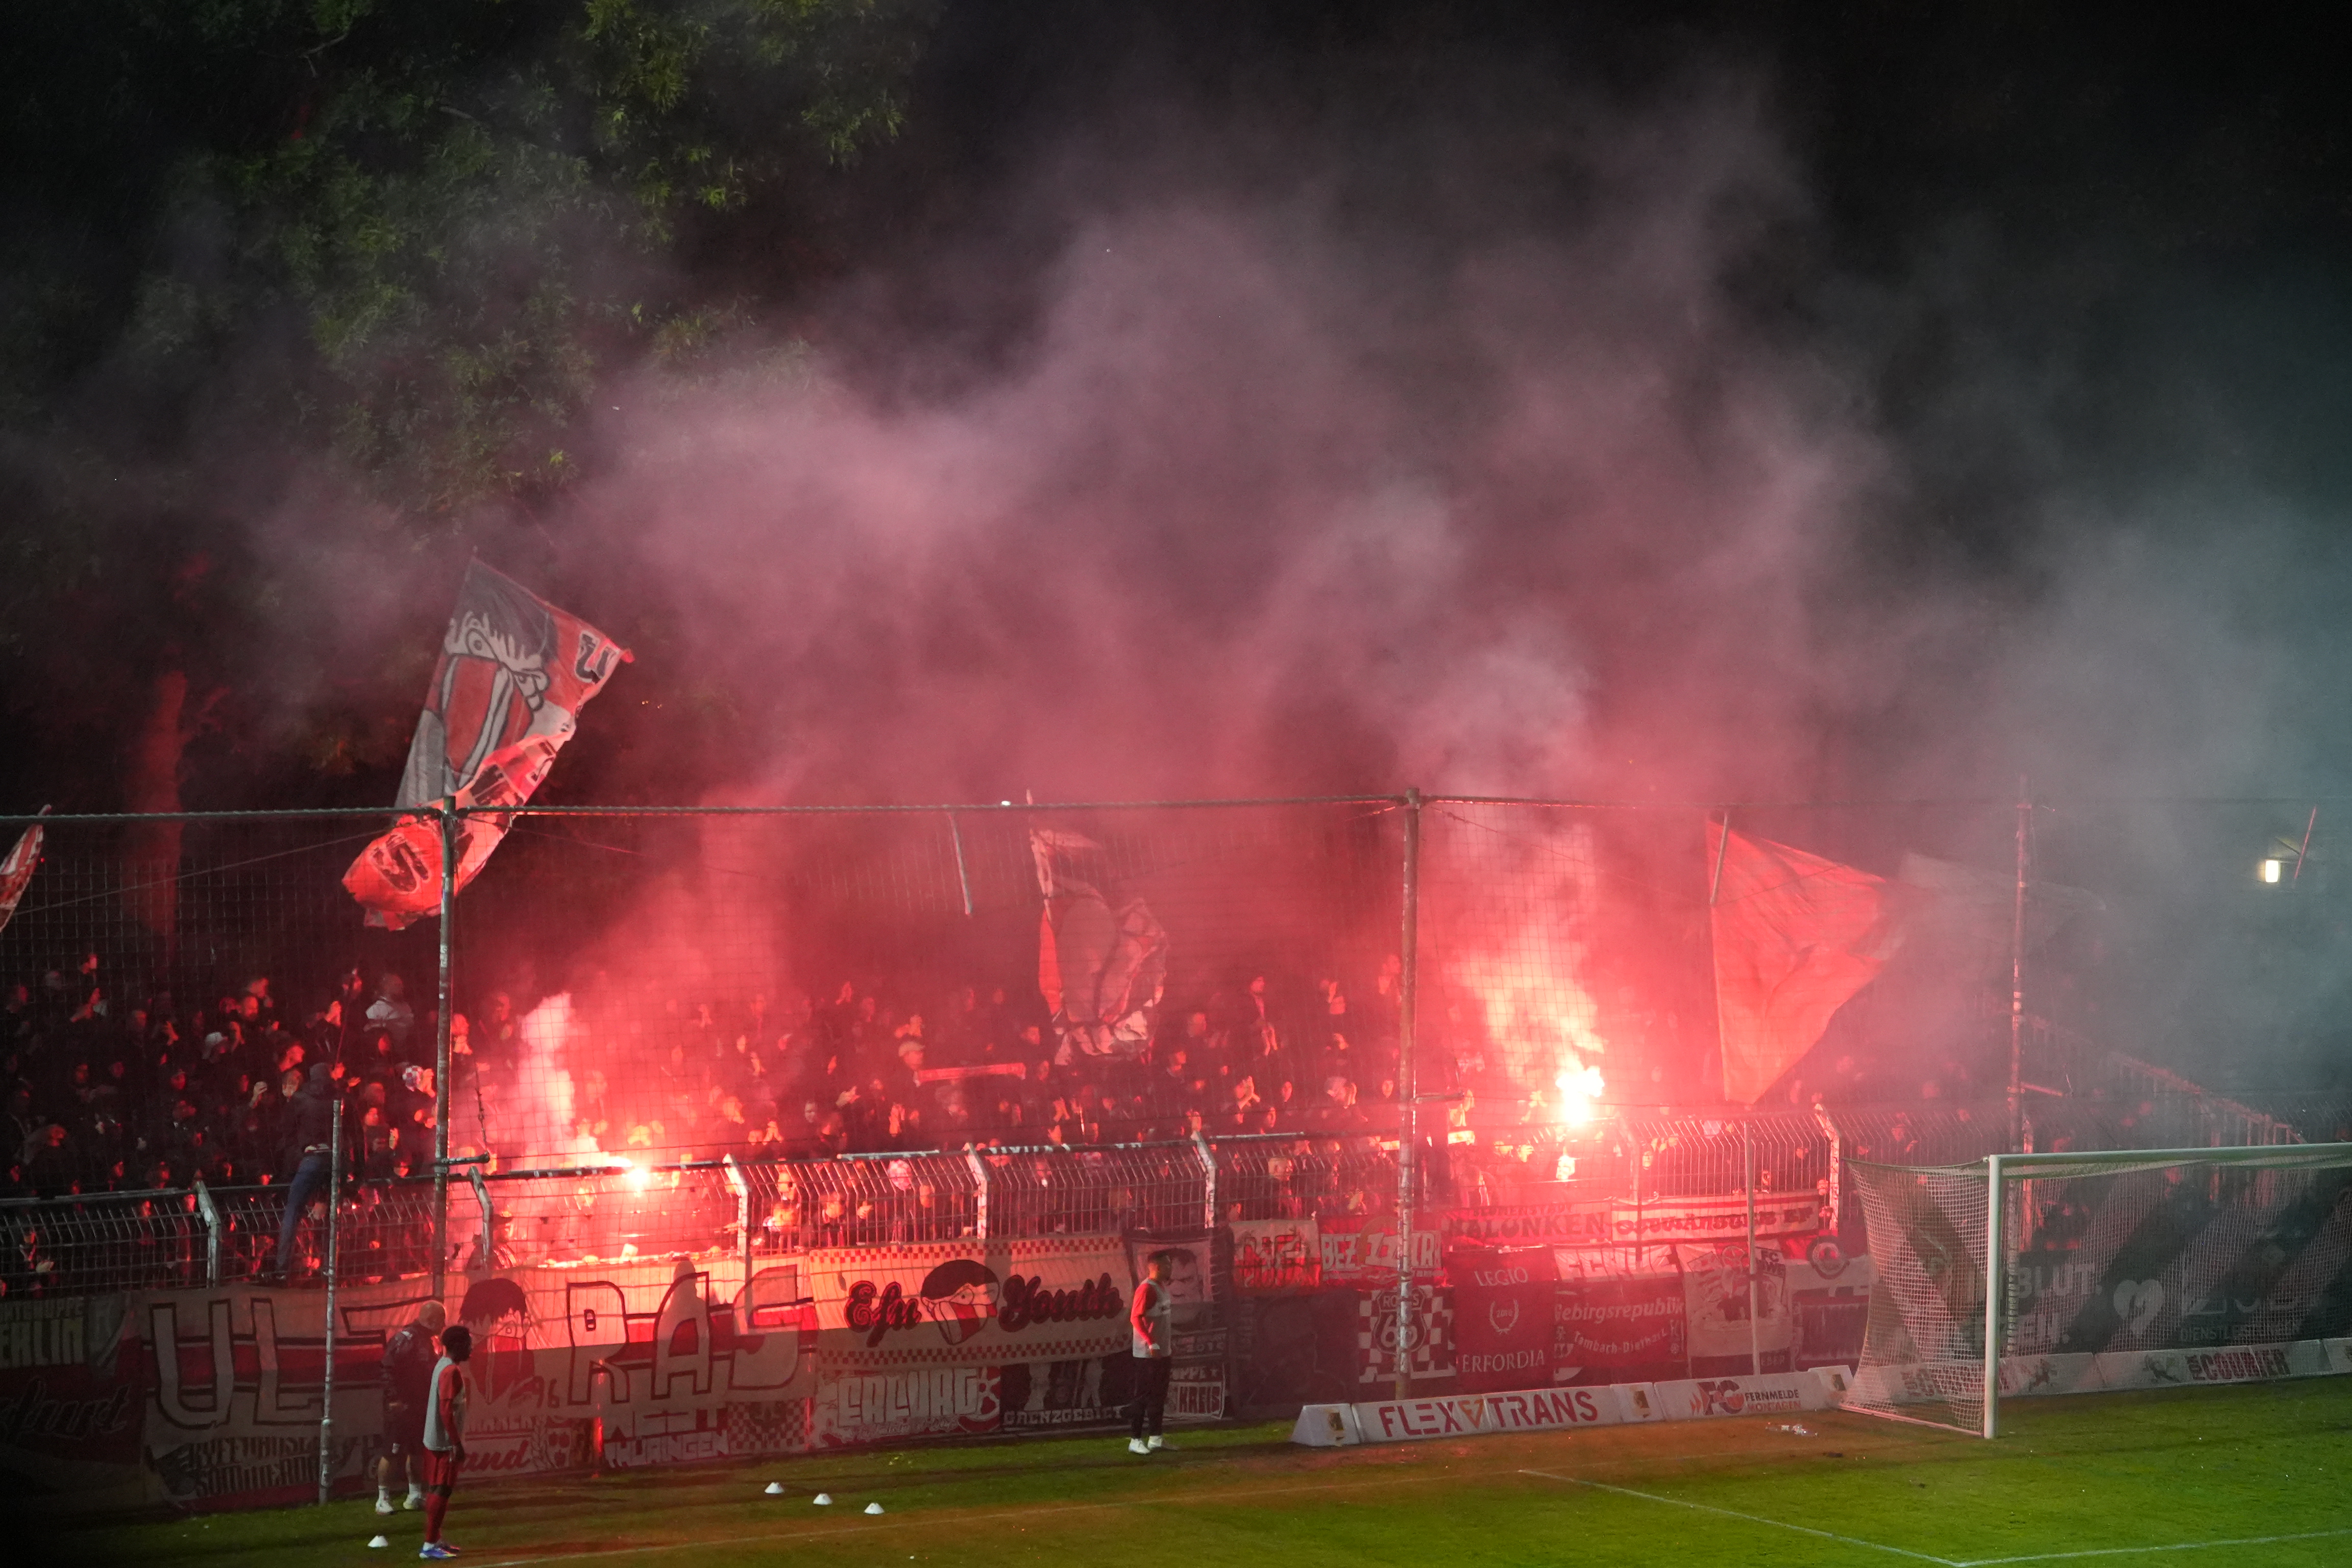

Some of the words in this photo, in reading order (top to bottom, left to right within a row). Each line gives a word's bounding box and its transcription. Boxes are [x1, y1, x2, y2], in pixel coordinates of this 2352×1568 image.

[1474, 1266, 1528, 1286] LEGIO
[1462, 1349, 1546, 1373] ERFORDIA
[2200, 1349, 2292, 1380] COURIER
[1744, 1389, 1799, 1402] FERNMELDE
[1378, 1401, 1463, 1438] FLEX
[1490, 1390, 1599, 1429] TRANS
